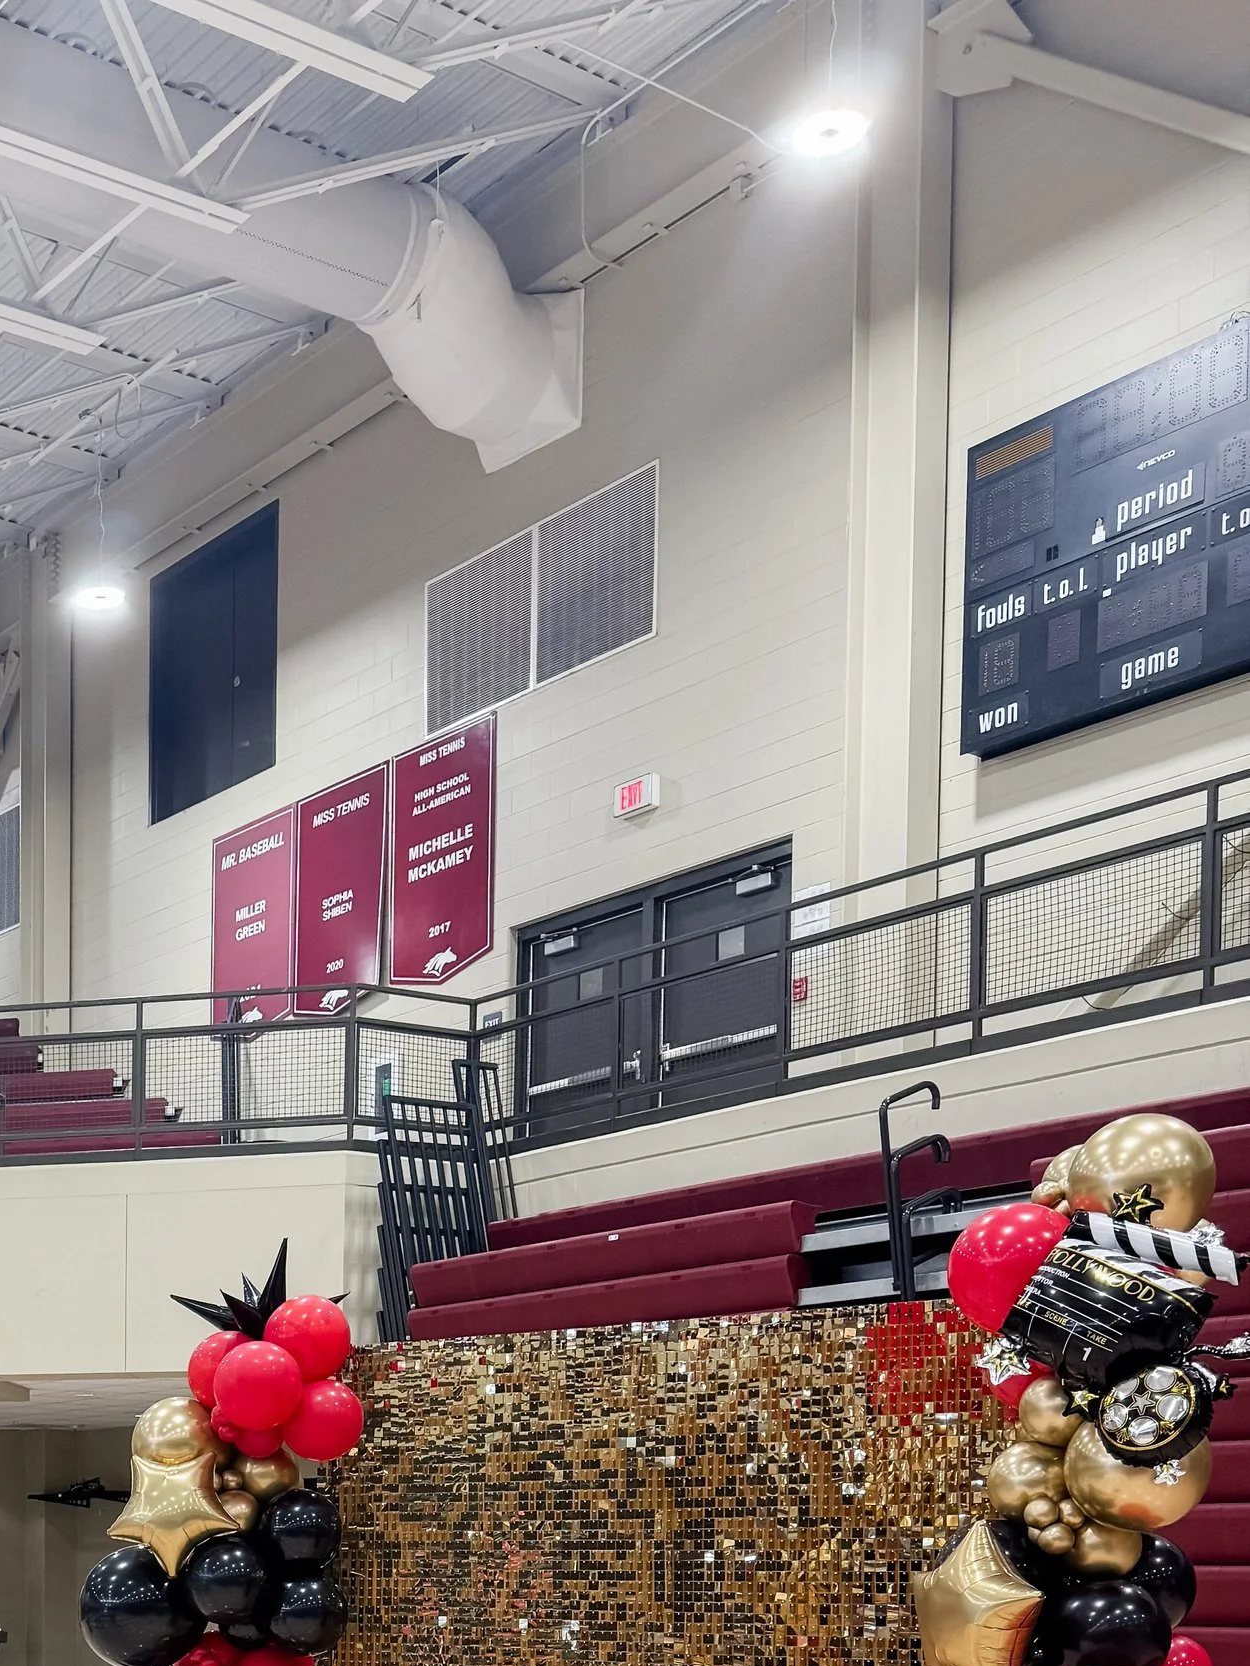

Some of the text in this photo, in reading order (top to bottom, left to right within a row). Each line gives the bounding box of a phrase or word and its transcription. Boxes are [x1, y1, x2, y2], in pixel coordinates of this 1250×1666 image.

[1116, 468, 1194, 533] period
[1115, 526, 1193, 583] player
[1043, 567, 1089, 605] t.o.l.
[976, 593, 1026, 633] fouls
[1120, 646, 1180, 690] game
[978, 701, 1019, 734] won
[419, 736, 466, 767] MISS TENNIS
[411, 783, 471, 817] ALL-AMERICAN
[414, 772, 470, 803] HIGH SCHOOL
[620, 780, 643, 811] EXIT
[312, 792, 371, 829] MISS TENNIS
[221, 831, 285, 872] MR. BASEBALL
[408, 822, 474, 862] MICHELLE
[407, 844, 474, 884] MCKAMEY
[235, 899, 267, 923] MILLER
[321, 888, 354, 910] SOPHIA
[322, 900, 353, 922] SHIBEN
[235, 919, 266, 942] GREEN
[428, 920, 452, 939] 2017
[326, 958, 344, 974] 2020
[1085, 1330, 1108, 1345] TAKE
[1081, 1346, 1093, 1362] 1
